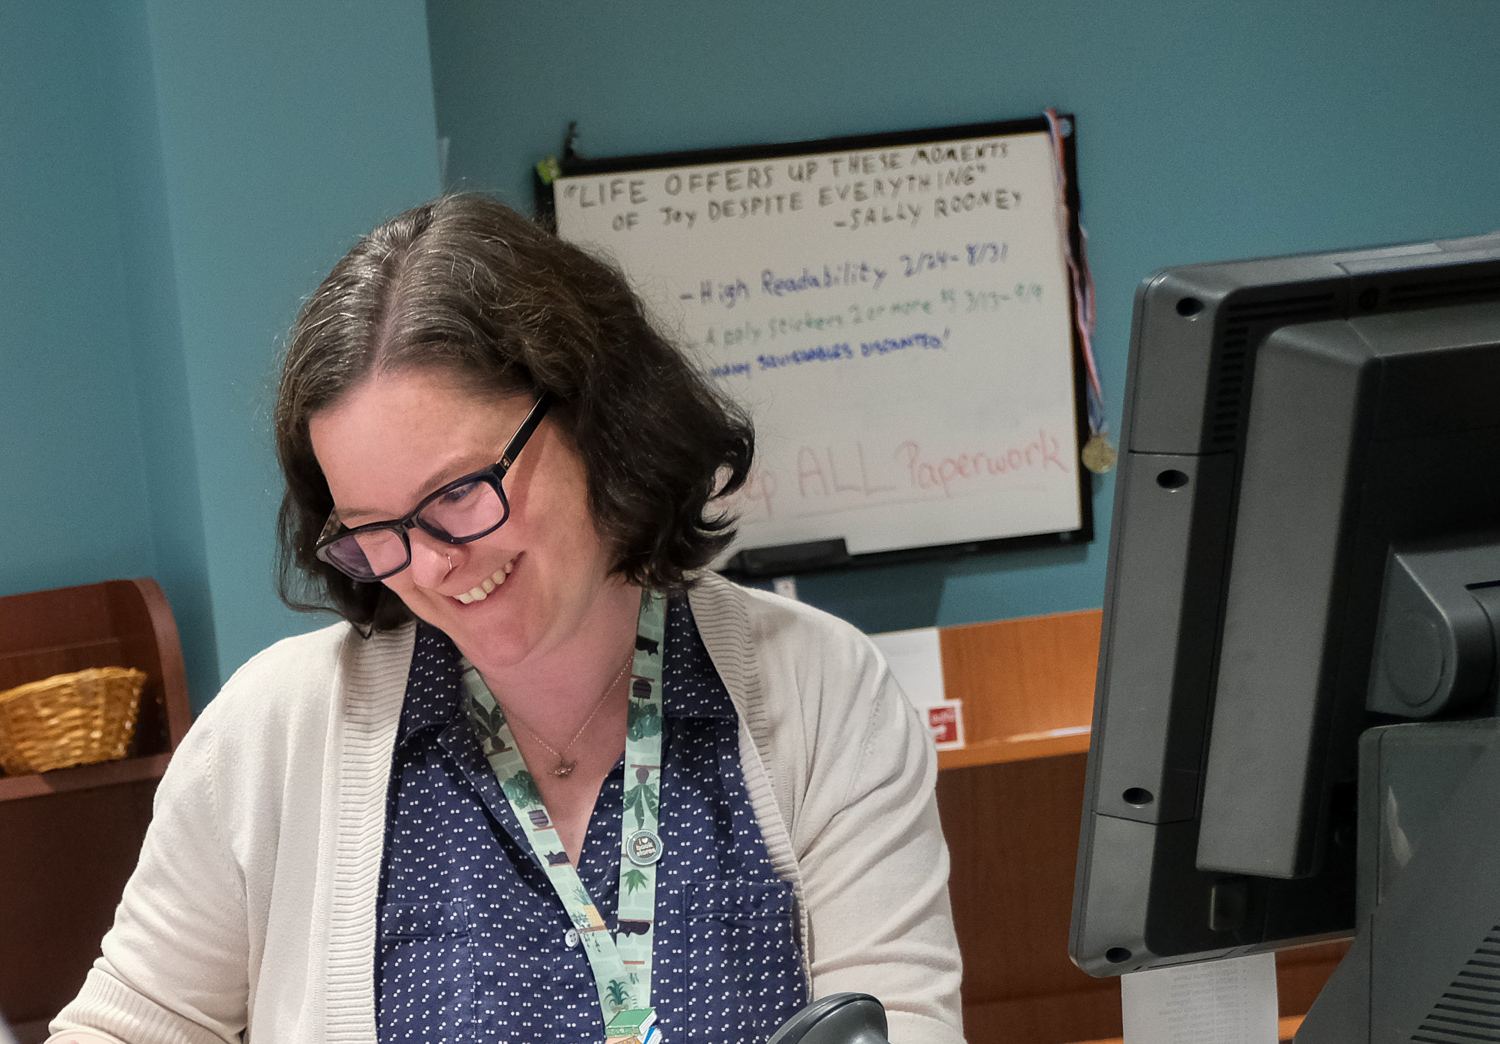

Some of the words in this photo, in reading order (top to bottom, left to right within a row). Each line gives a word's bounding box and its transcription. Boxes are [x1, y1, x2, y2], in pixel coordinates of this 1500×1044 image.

[664, 164, 775, 196] OFFERS
[787, 159, 819, 183] UP
[829, 152, 903, 178] THESE
[611, 211, 641, 232] OF
[707, 191, 804, 223] DESPITE
[933, 187, 1022, 218] ROONEY
[797, 441, 896, 497] ALL
[894, 428, 1071, 497] Paperwork
